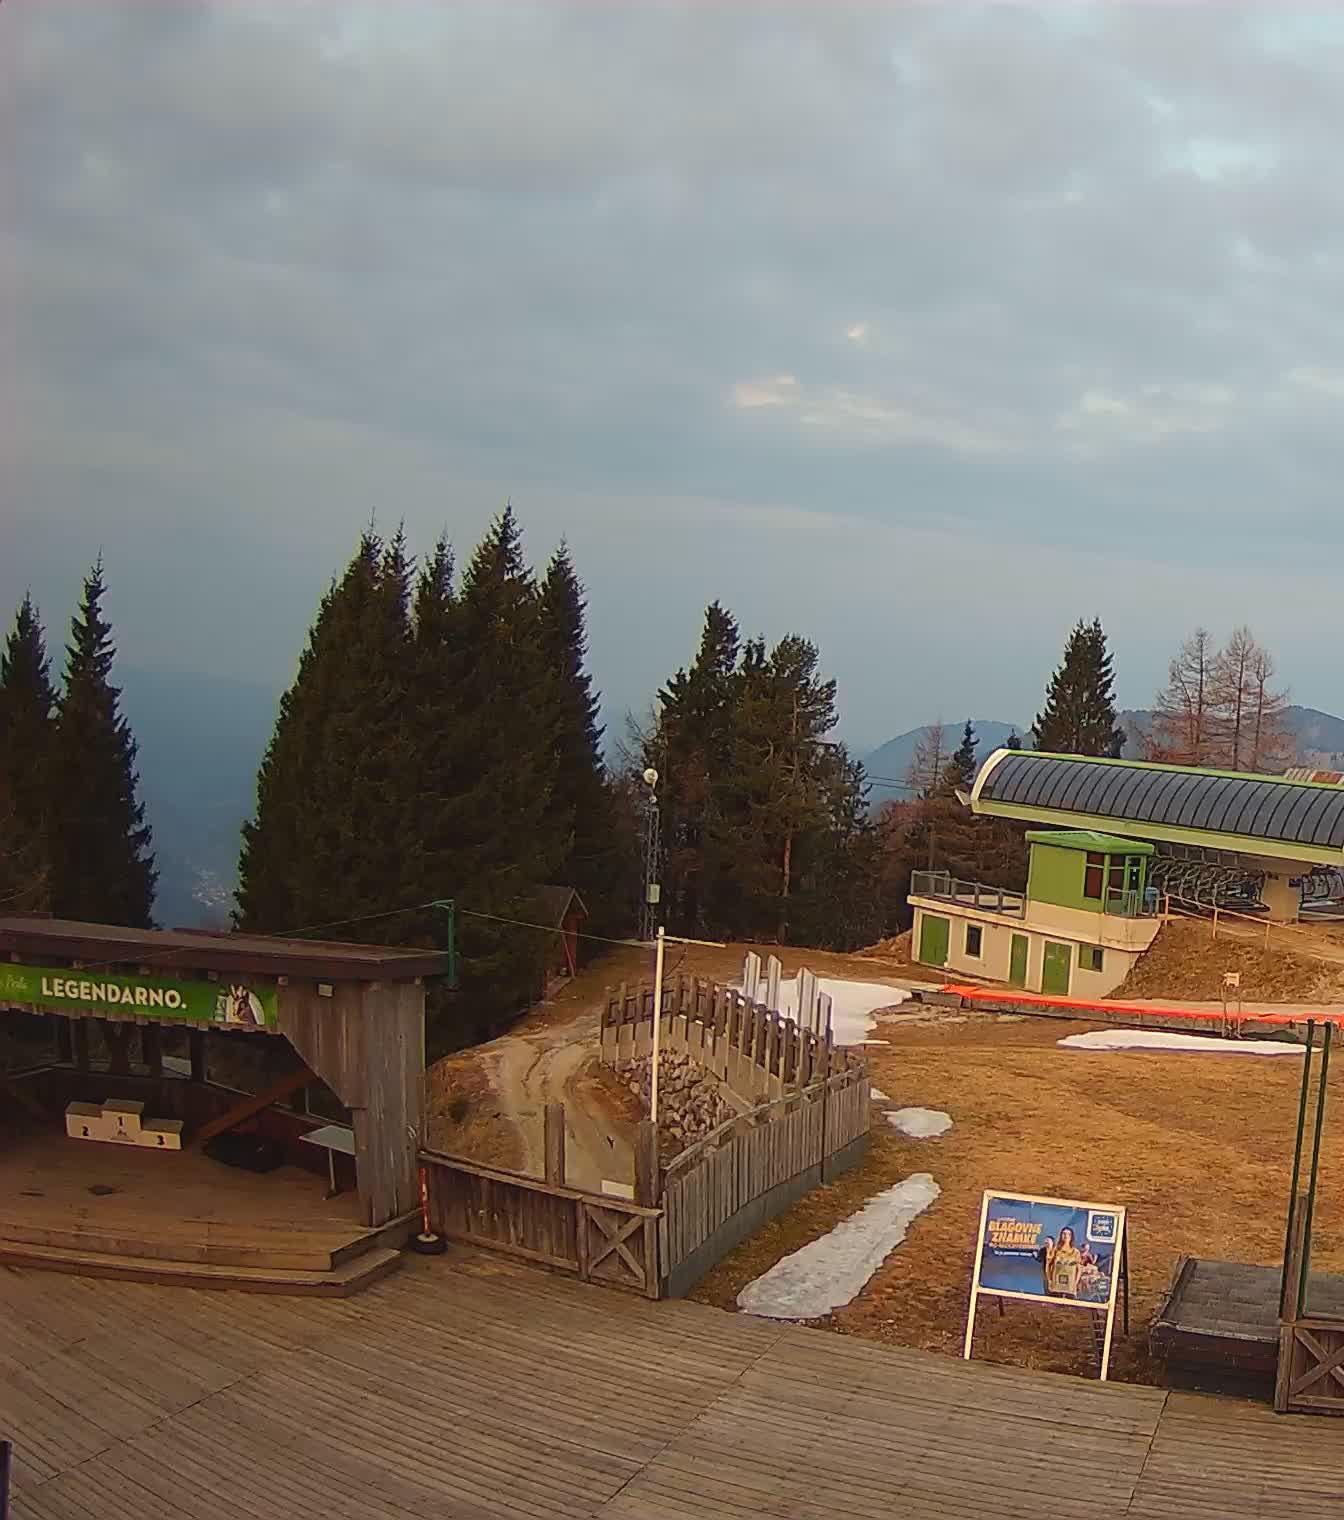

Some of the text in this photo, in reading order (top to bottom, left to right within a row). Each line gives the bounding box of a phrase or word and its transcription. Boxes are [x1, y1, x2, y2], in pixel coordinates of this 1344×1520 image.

[41, 977, 187, 1009] LEGENDARNO.
[989, 1220, 1042, 1233] BLAGOVNE
[991, 1231, 1038, 1244] ZNAMKE
